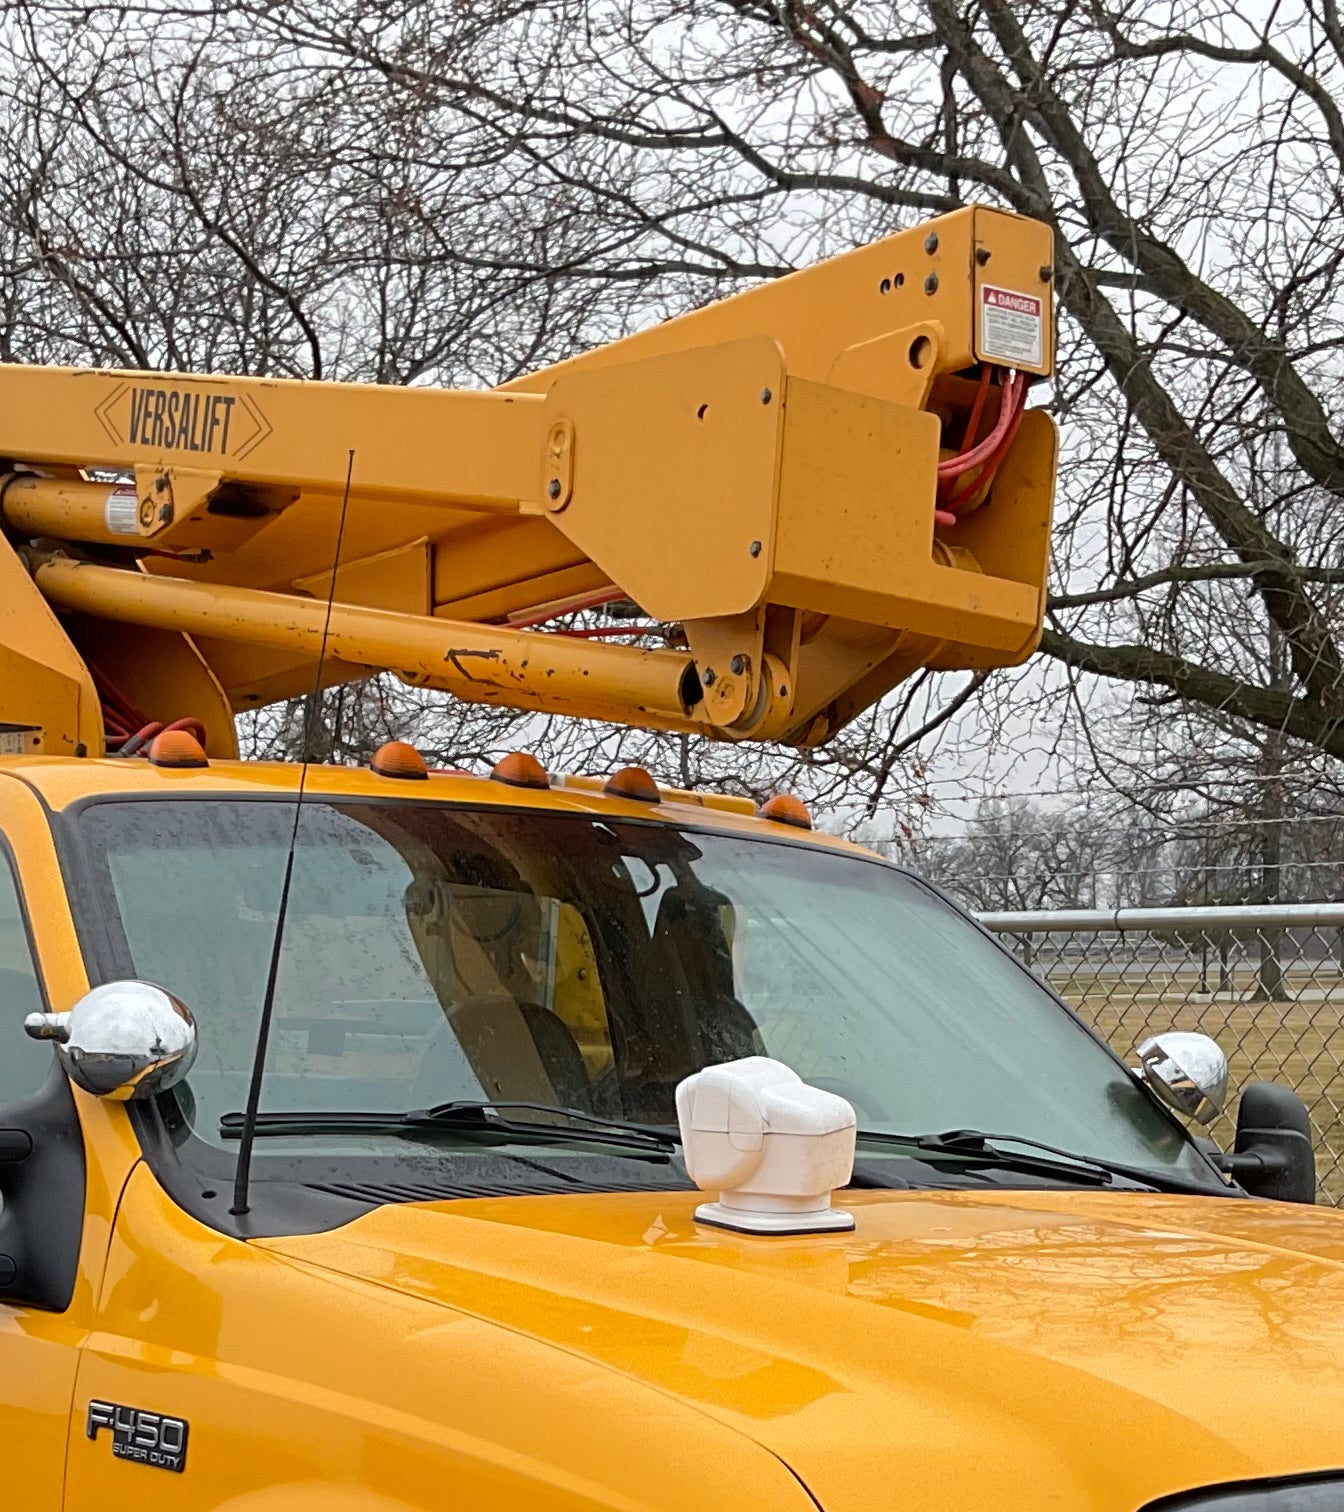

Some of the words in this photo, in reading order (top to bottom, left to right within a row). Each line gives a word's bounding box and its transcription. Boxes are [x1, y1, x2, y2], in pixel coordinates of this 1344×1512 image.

[997, 293, 1037, 314] DANGER
[130, 387, 235, 455] VERSALIFT
[86, 1401, 184, 1454] F-450
[112, 1442, 147, 1460] SUPER
[150, 1452, 181, 1468] DUTY
